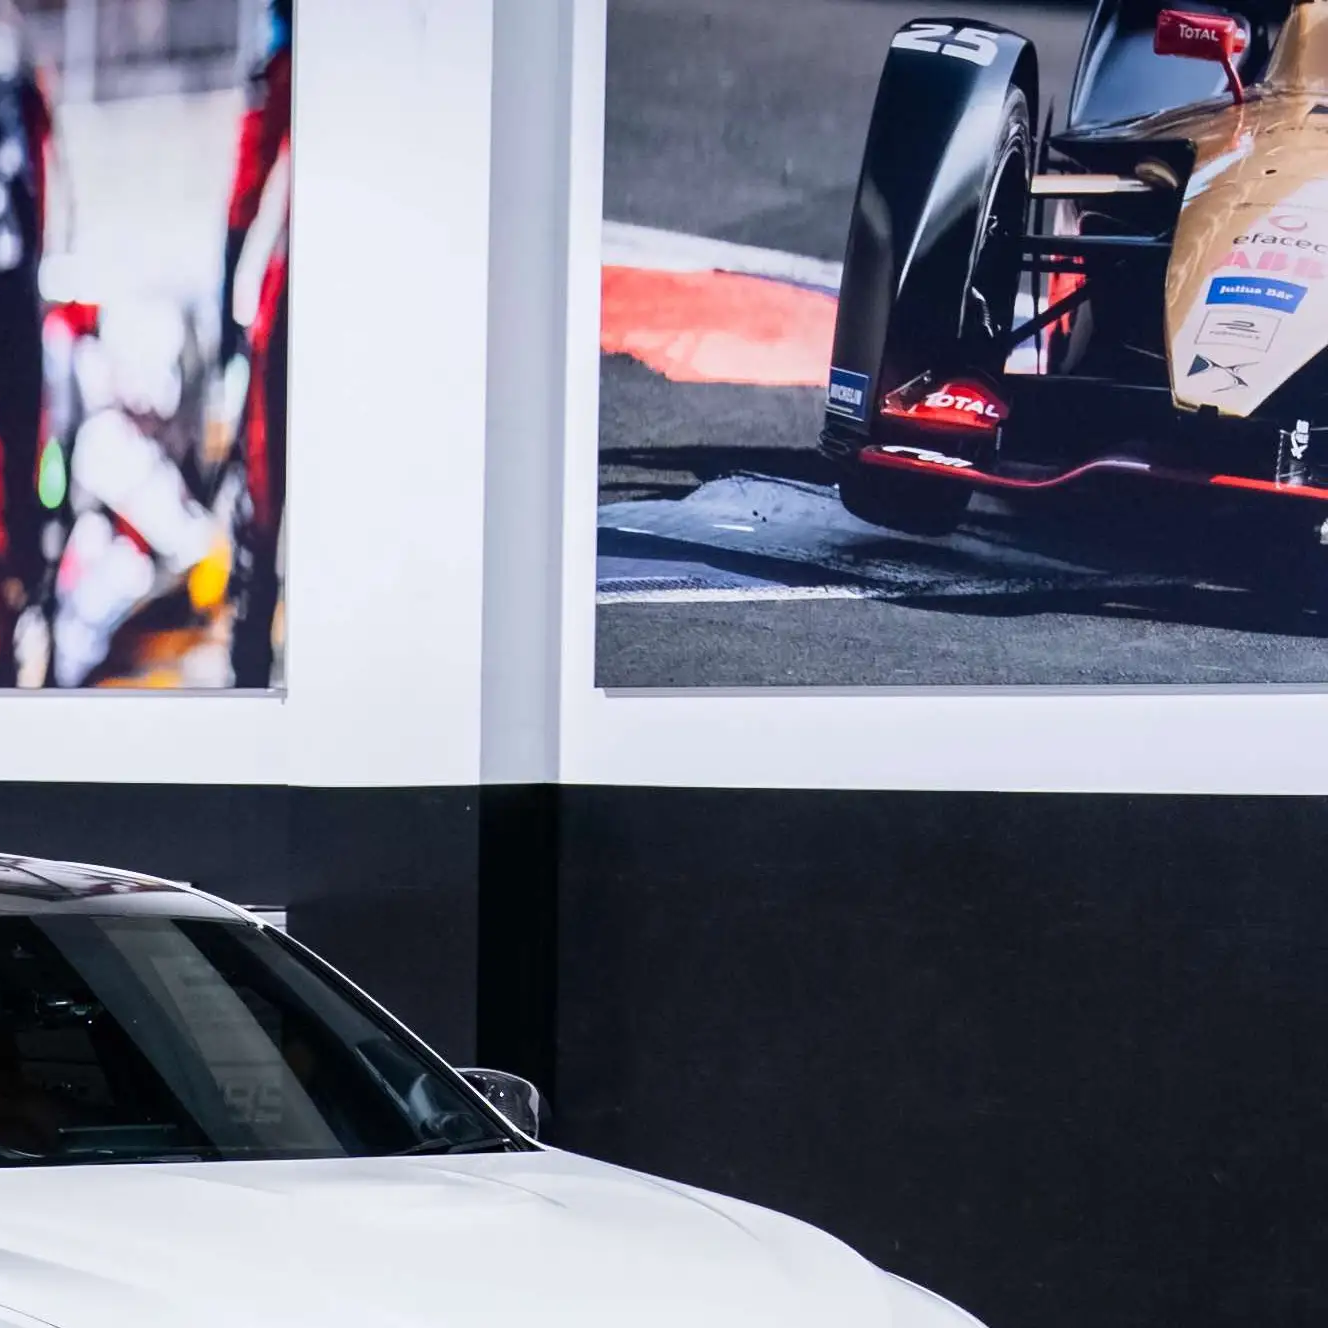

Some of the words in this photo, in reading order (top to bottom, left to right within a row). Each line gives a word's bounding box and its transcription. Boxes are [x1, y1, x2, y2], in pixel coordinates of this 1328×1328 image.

[891, 24, 998, 66] 25
[1179, 23, 1219, 41] TOTAL
[925, 391, 1000, 419] TOTAL
